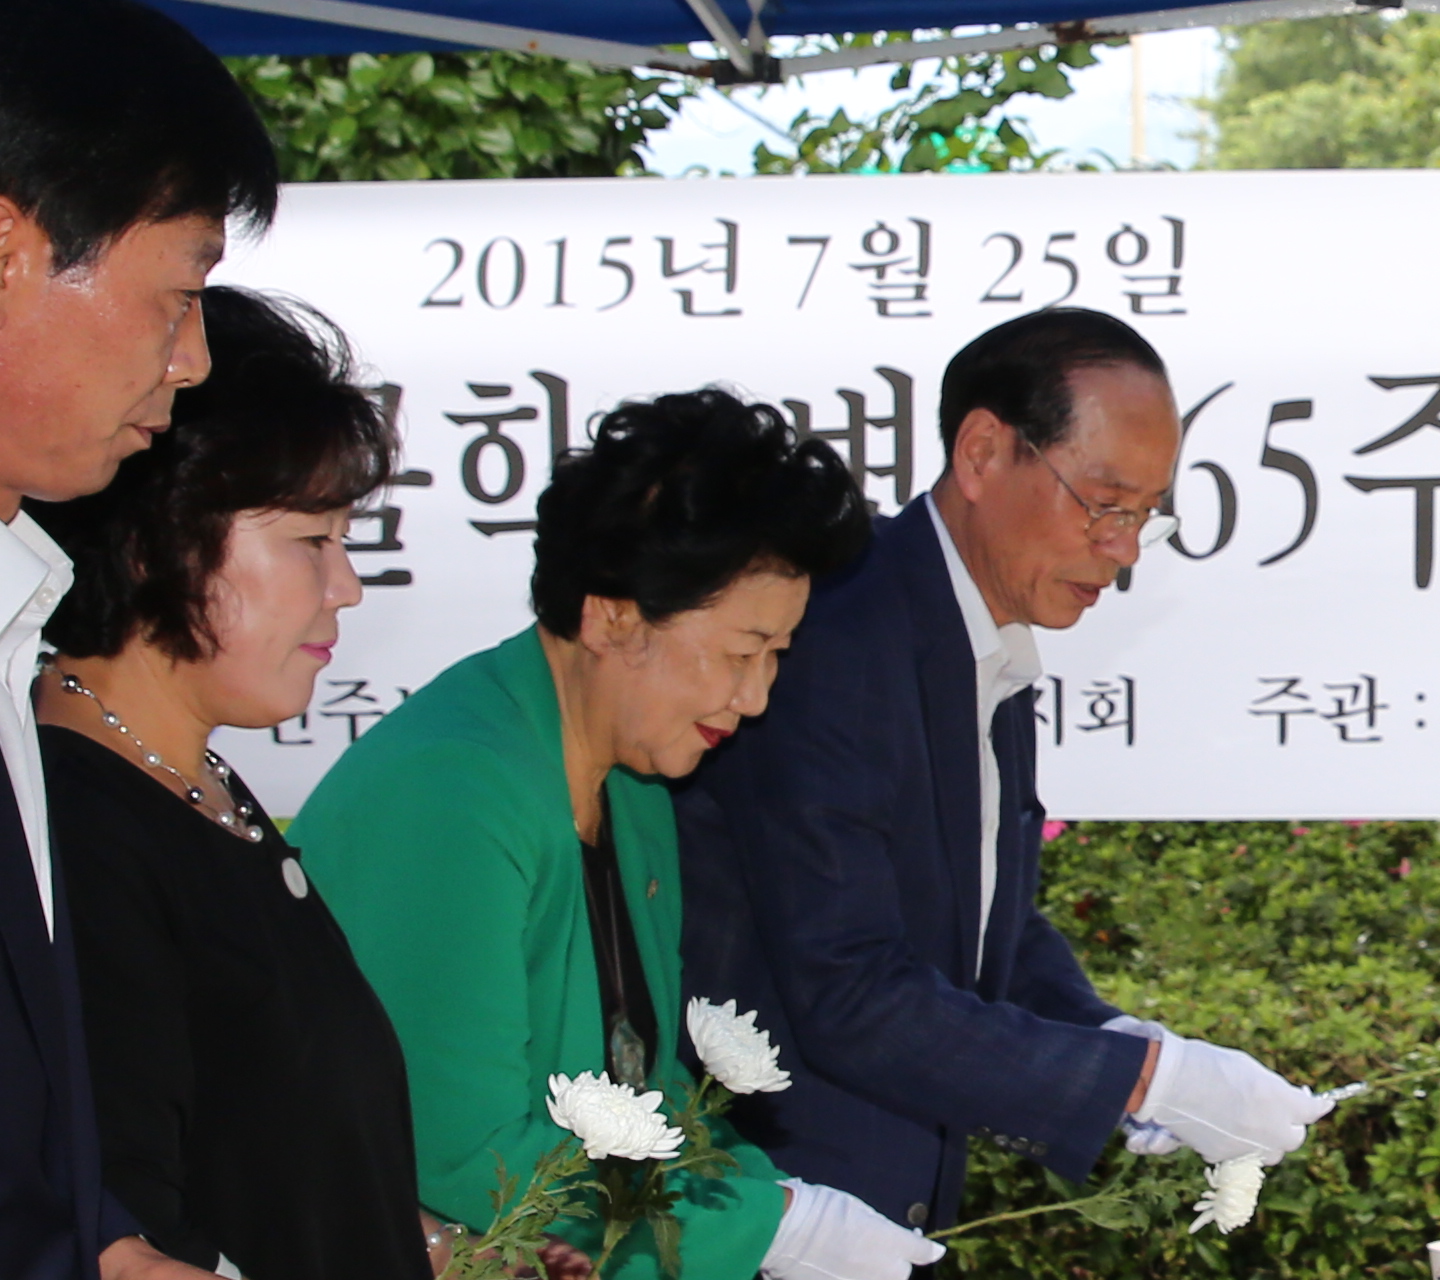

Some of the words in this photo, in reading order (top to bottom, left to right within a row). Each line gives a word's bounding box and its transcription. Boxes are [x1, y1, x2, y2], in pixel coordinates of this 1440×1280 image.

[420, 217, 742, 318] 2015년
[785, 217, 935, 318] 7월
[978, 214, 1188, 317] 25일
[1247, 672, 1390, 746] 주관
